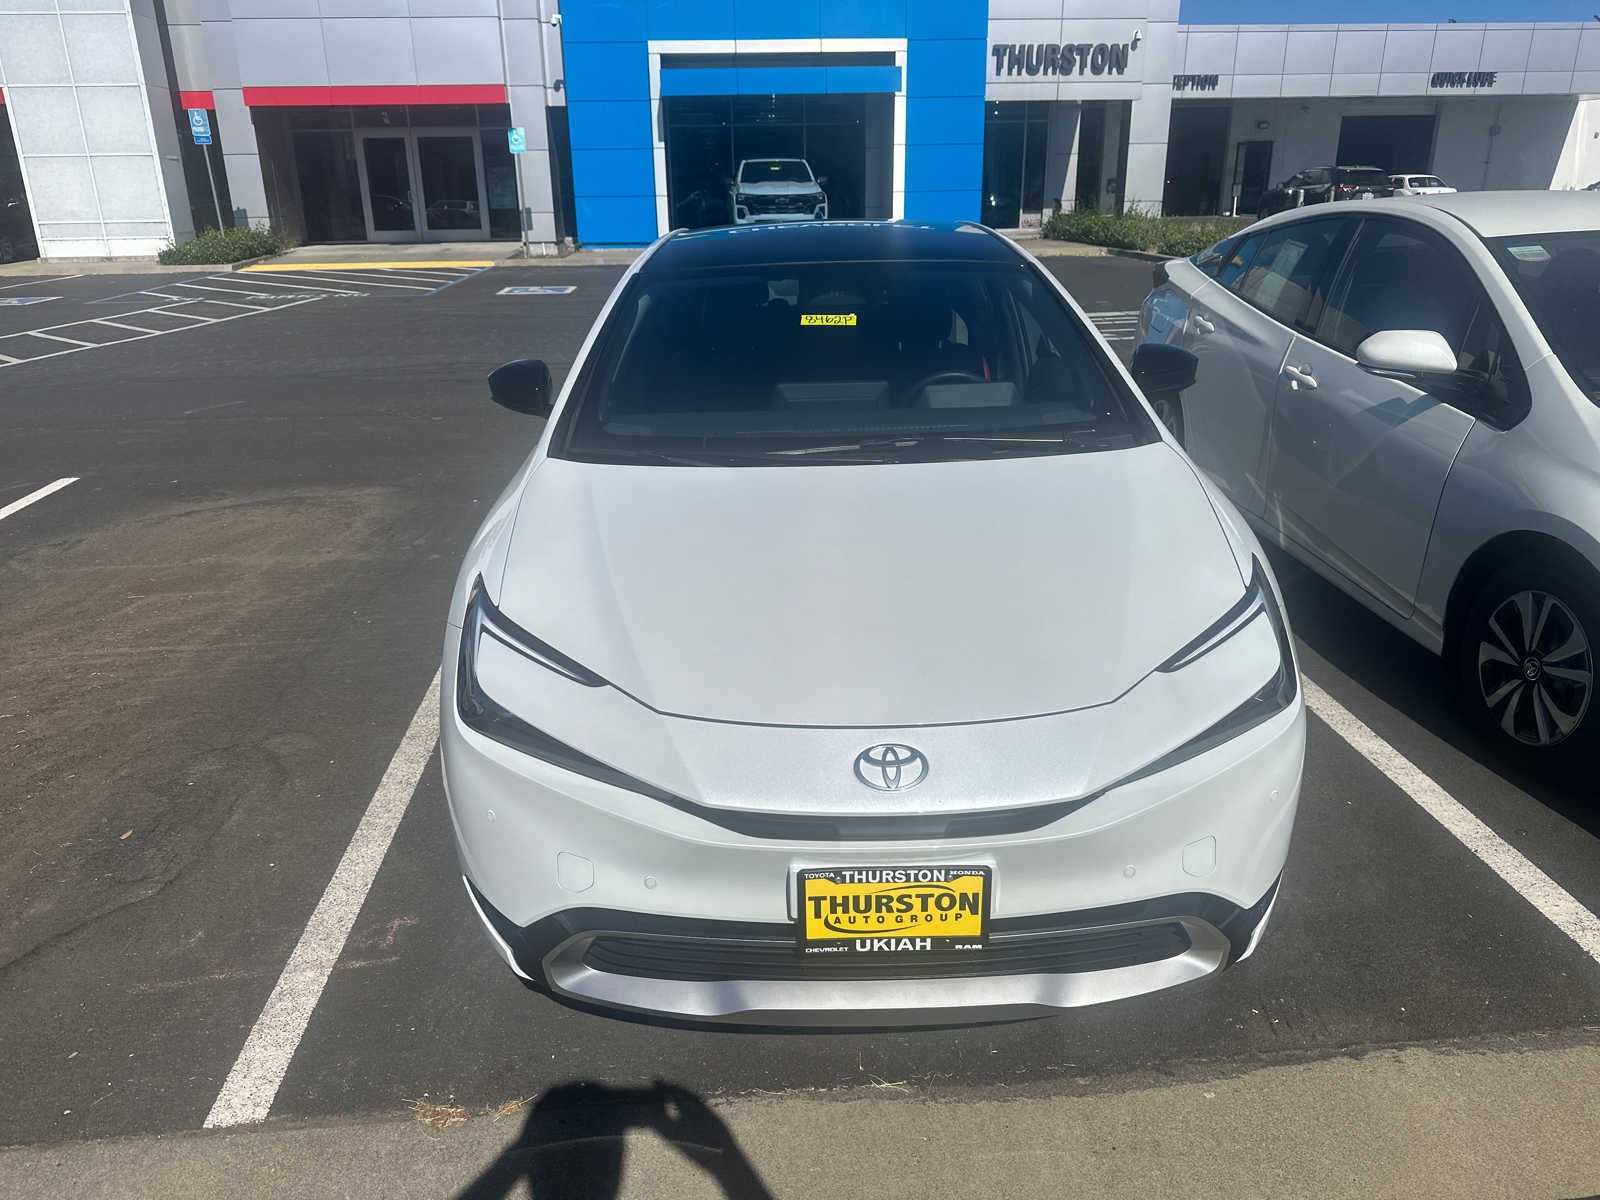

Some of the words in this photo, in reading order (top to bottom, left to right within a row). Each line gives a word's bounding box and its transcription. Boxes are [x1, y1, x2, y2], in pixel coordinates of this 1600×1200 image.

[992, 43, 1129, 76] THURSTON
[842, 870, 945, 883] THURSTON
[808, 892, 979, 919] THURSTON
[833, 916, 886, 925] AUTO
[895, 913, 963, 924] GROUP
[855, 938, 932, 951] UKIAH
